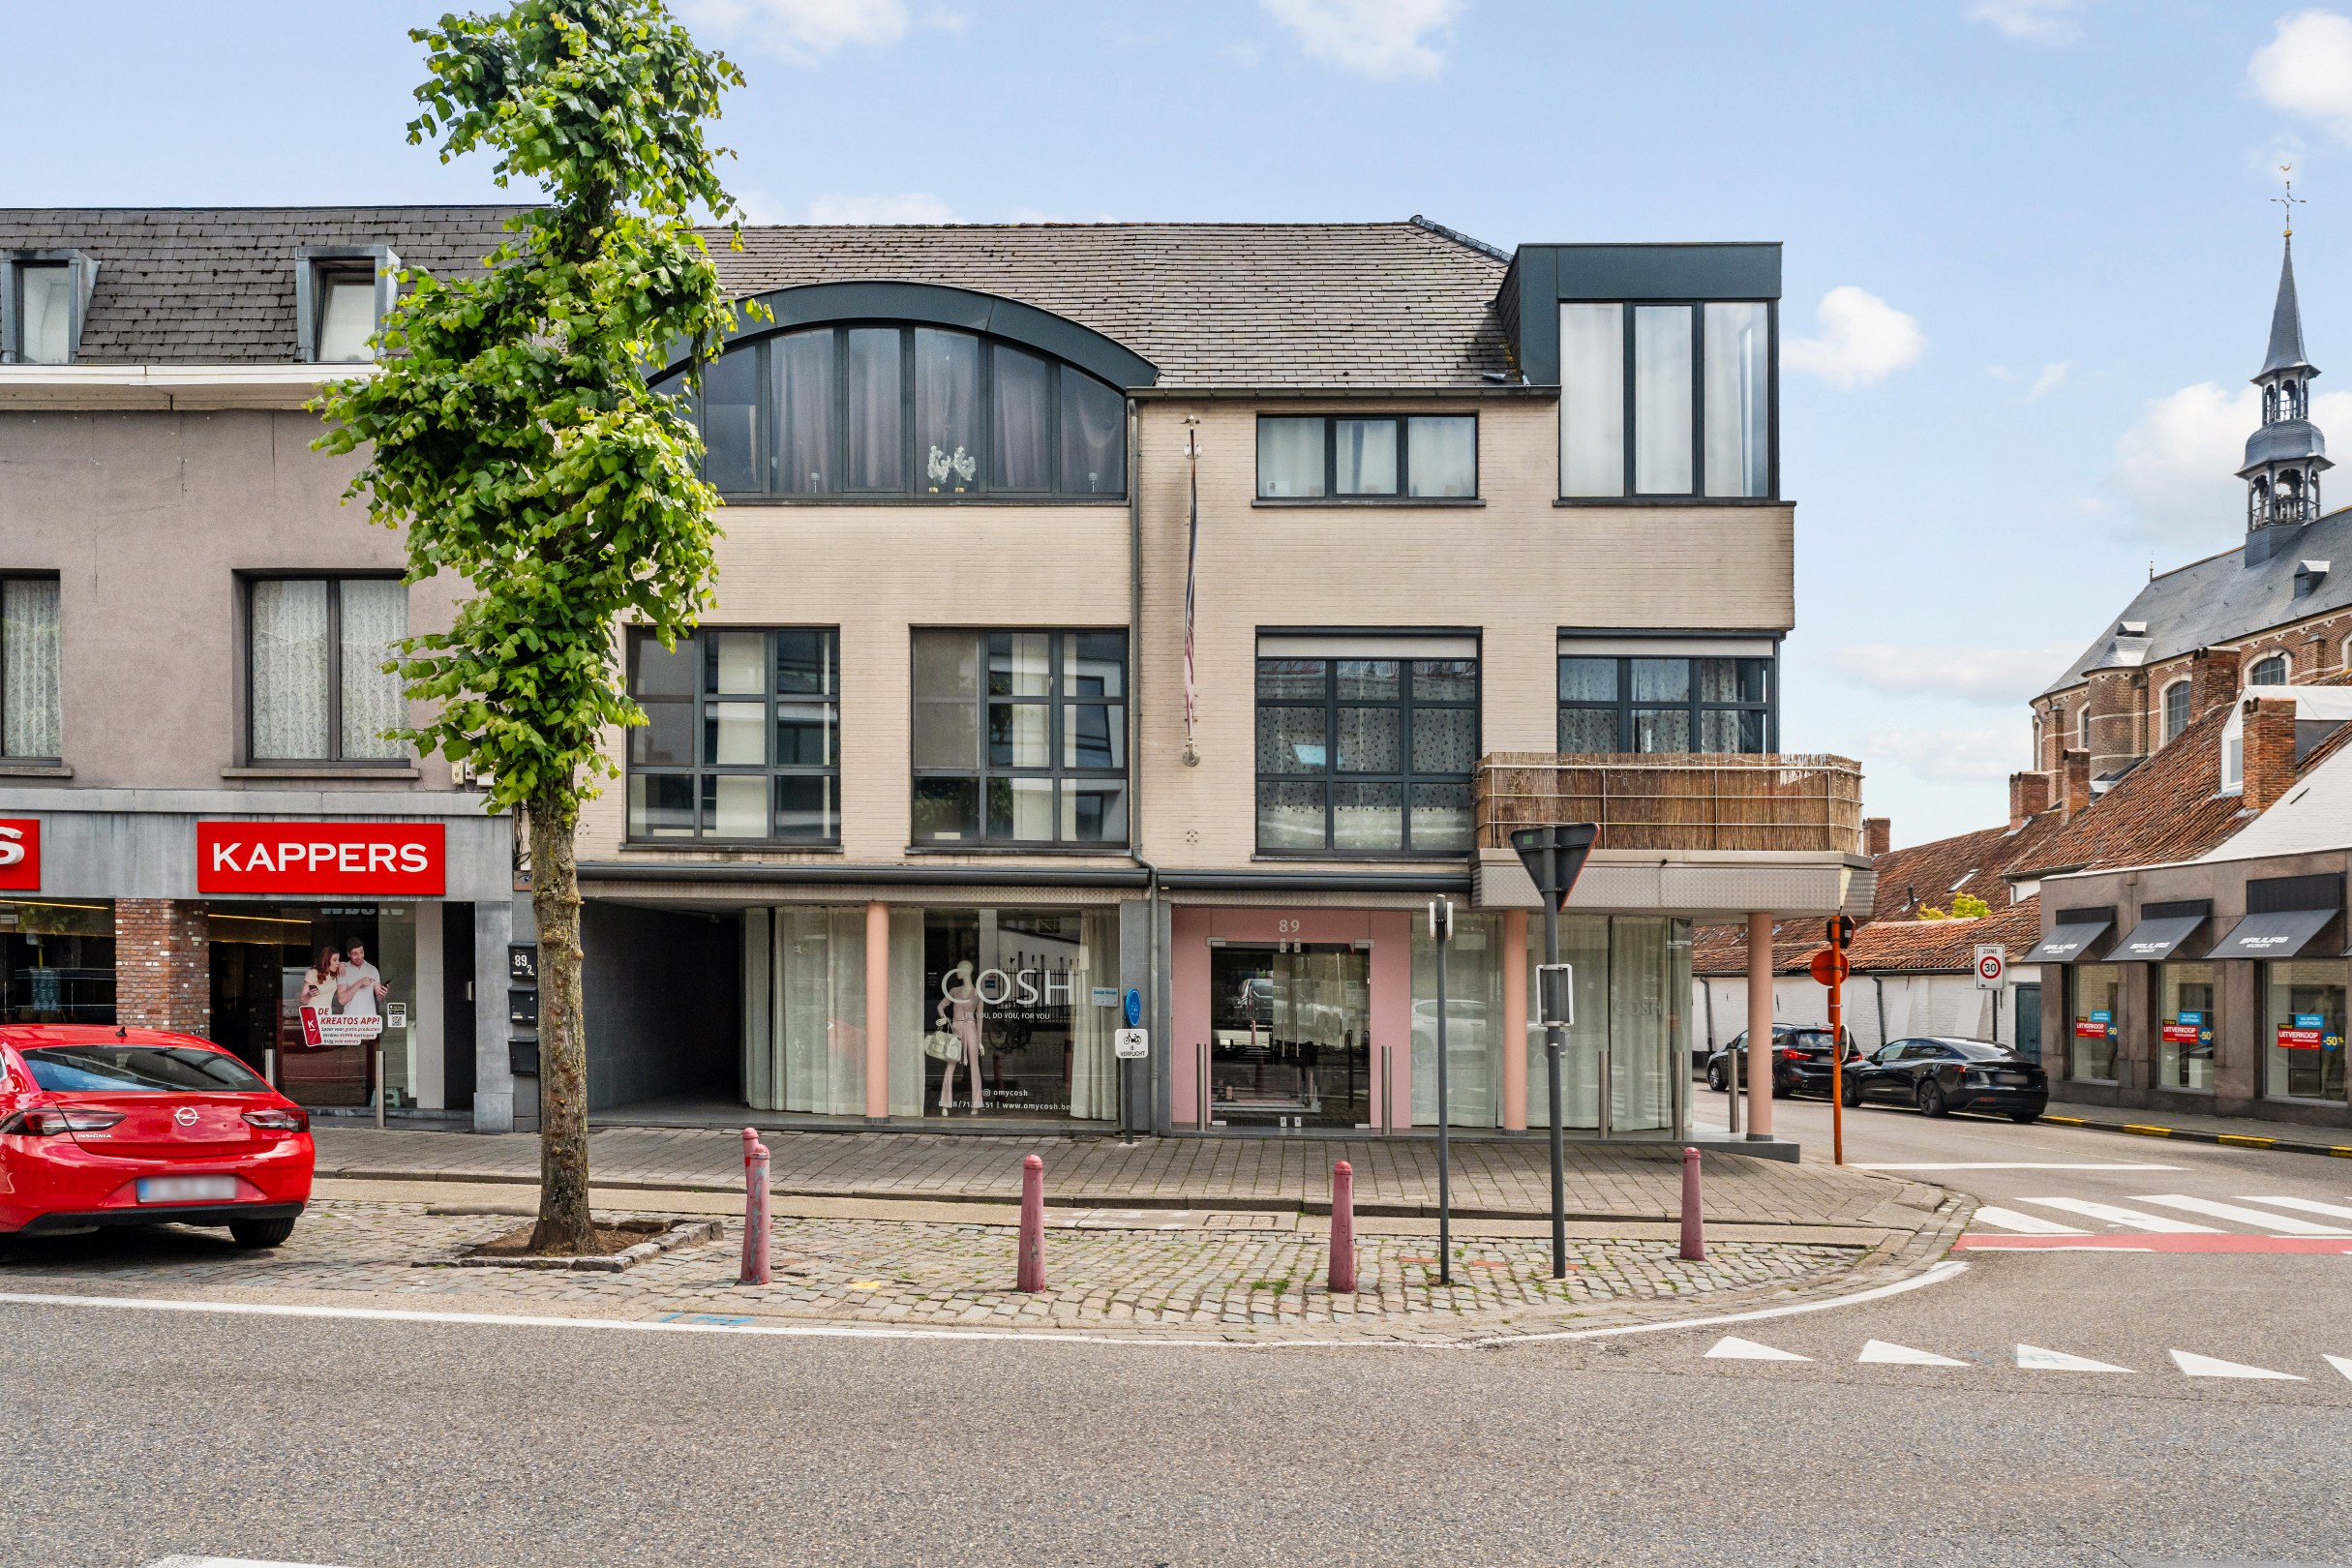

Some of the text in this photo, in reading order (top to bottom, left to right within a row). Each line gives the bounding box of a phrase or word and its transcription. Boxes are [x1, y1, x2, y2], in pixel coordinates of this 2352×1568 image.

[213, 842, 429, 873] KAPPERS
[1279, 920, 1300, 933] 89
[514, 954, 528, 967] 89
[527, 964, 533, 974] 2
[1984, 963, 1997, 973] 30
[941, 968, 1072, 1005] COSH
[320, 1016, 380, 1025] KREATOS APP!
[992, 1011, 1003, 1020] DO
[1004, 1011, 1020, 1020] YOU,
[307, 1019, 316, 1029] K
[2278, 1031, 2318, 1040] UITVERKOOP
[993, 1089, 1028, 1098] omycosh
[1002, 1101, 1070, 1111] www.omycosh.be
